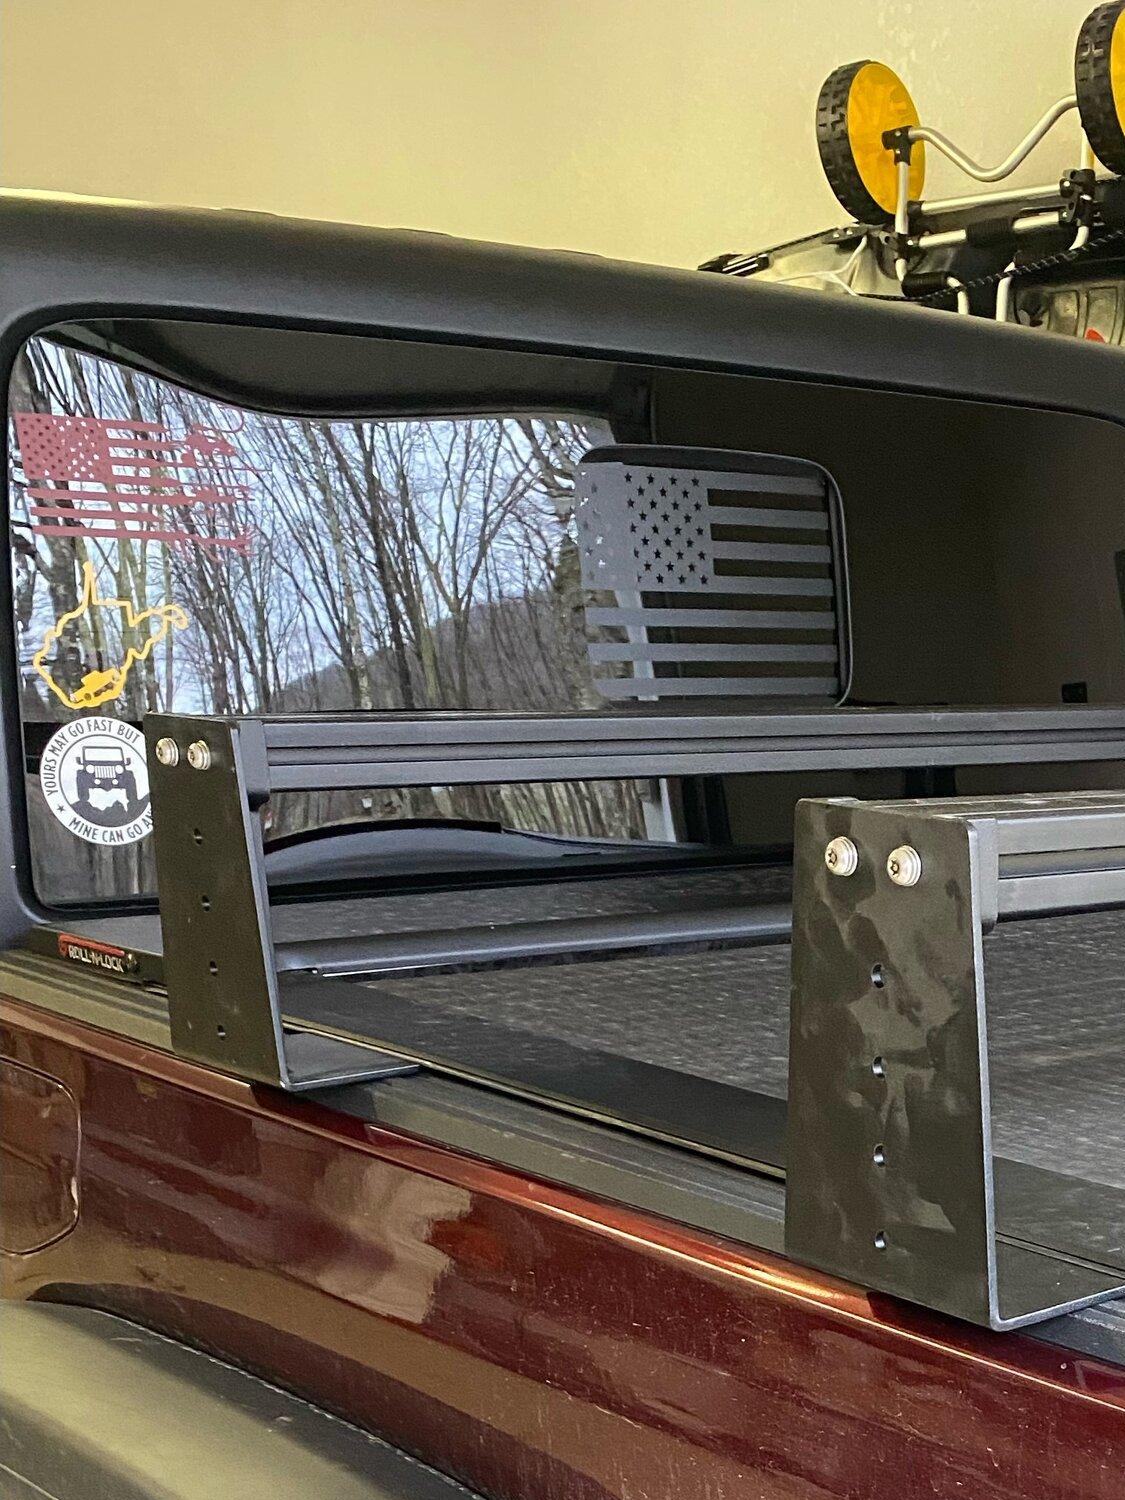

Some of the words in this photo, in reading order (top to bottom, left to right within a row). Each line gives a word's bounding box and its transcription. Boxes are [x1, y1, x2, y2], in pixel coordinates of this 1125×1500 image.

[68, 722, 85, 738] GO
[86, 719, 114, 733] FAST
[116, 724, 141, 744] BUT
[48, 732, 69, 757] MAY
[42, 757, 59, 796] YOURS
[68, 817, 99, 841] MINE
[101, 831, 125, 843] CAN
[126, 823, 143, 839] GO
